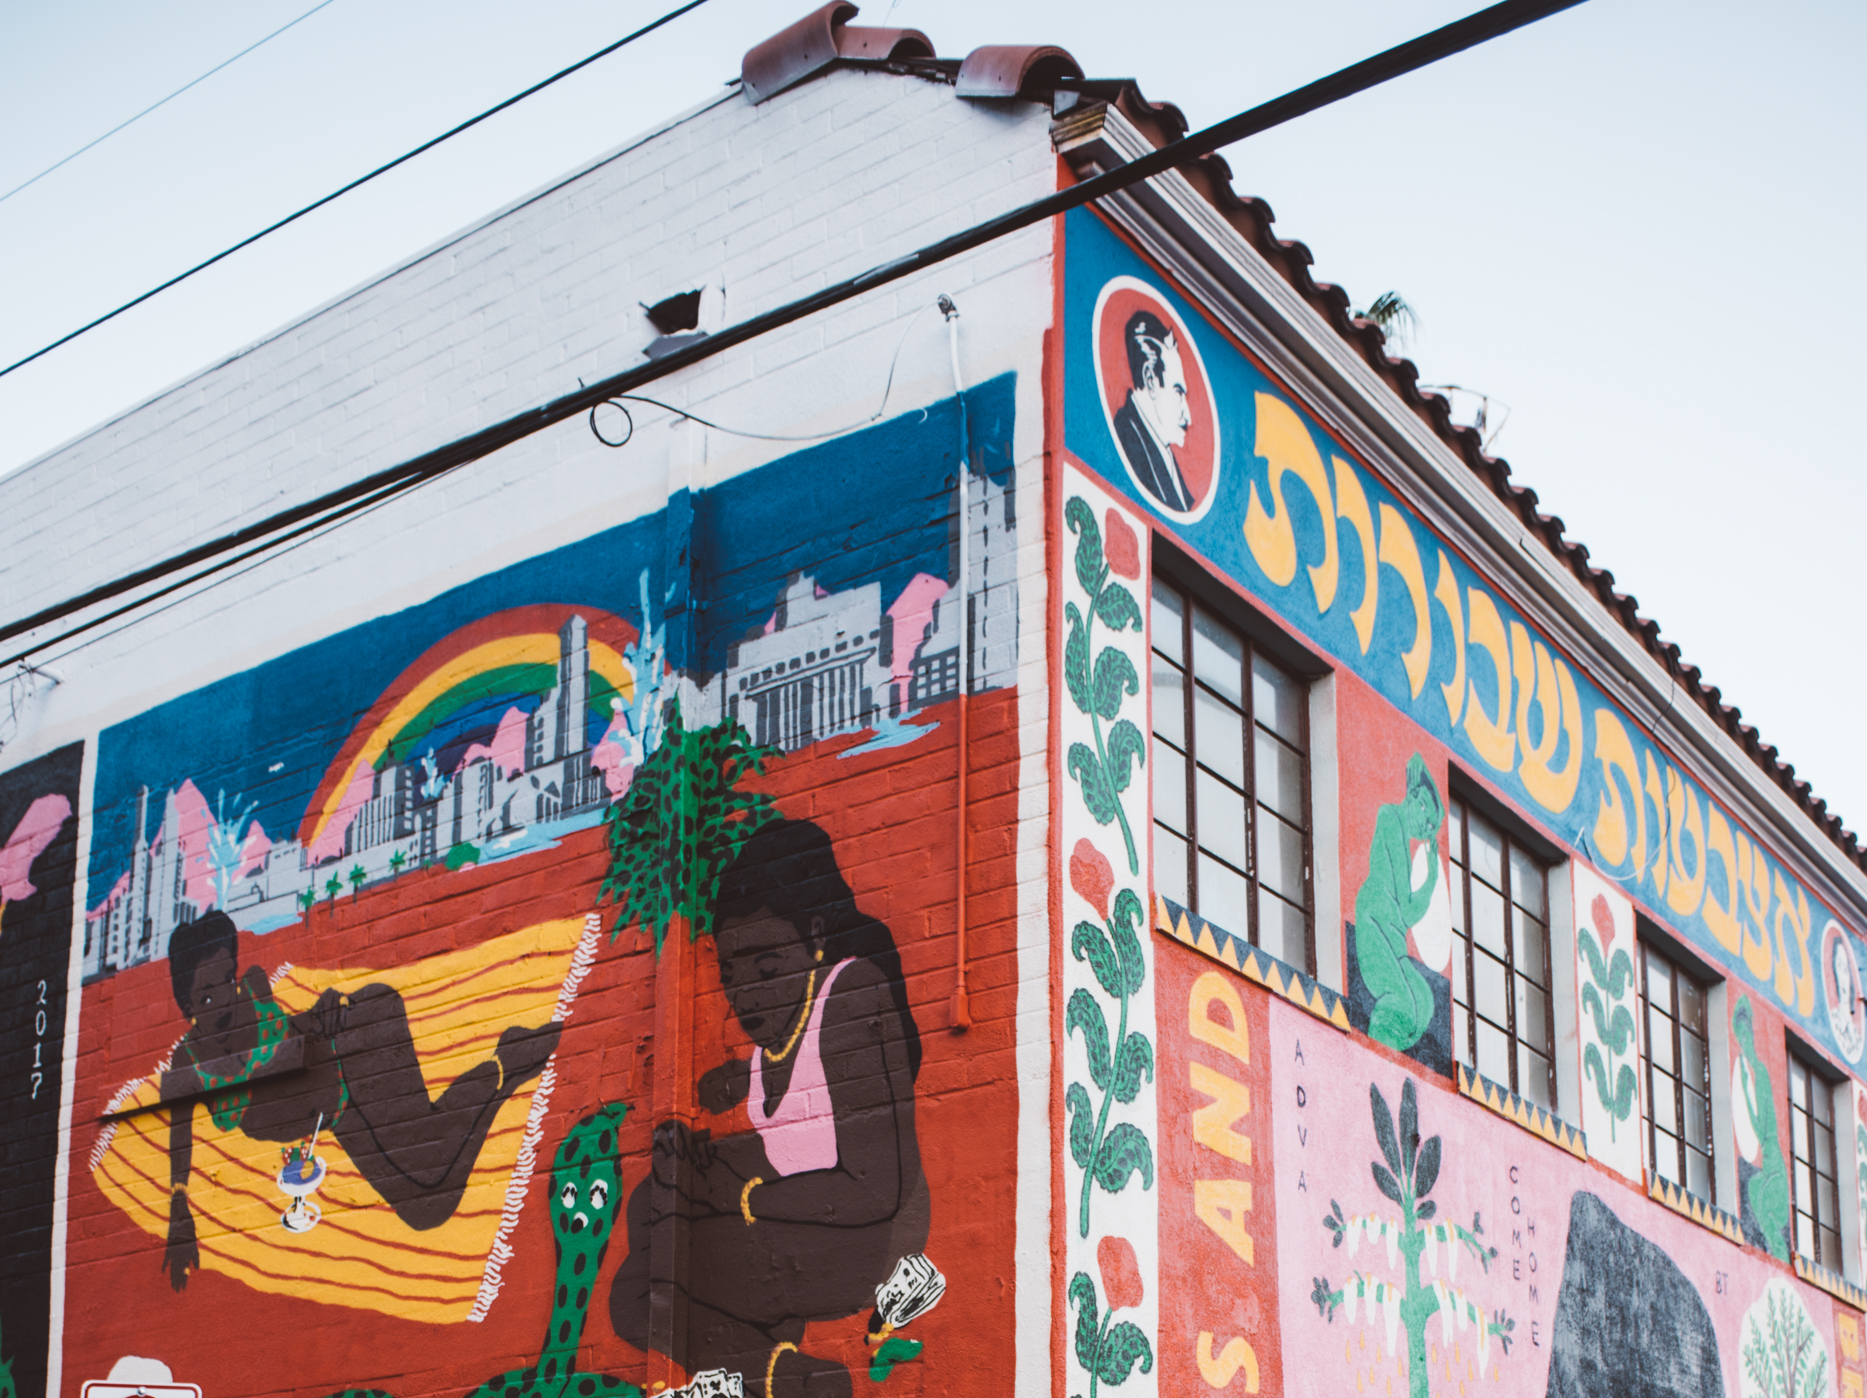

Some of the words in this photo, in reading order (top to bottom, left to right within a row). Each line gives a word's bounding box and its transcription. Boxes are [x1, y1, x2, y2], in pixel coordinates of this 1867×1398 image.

[1242, 391, 1583, 814] שבורות
[31, 980, 47, 1100] 2017
[1188, 971, 1254, 1268] AND
[1294, 1039, 1307, 1192] ADVA
[1509, 1166, 1521, 1281] COME
[1527, 1216, 1540, 1347] HOME
